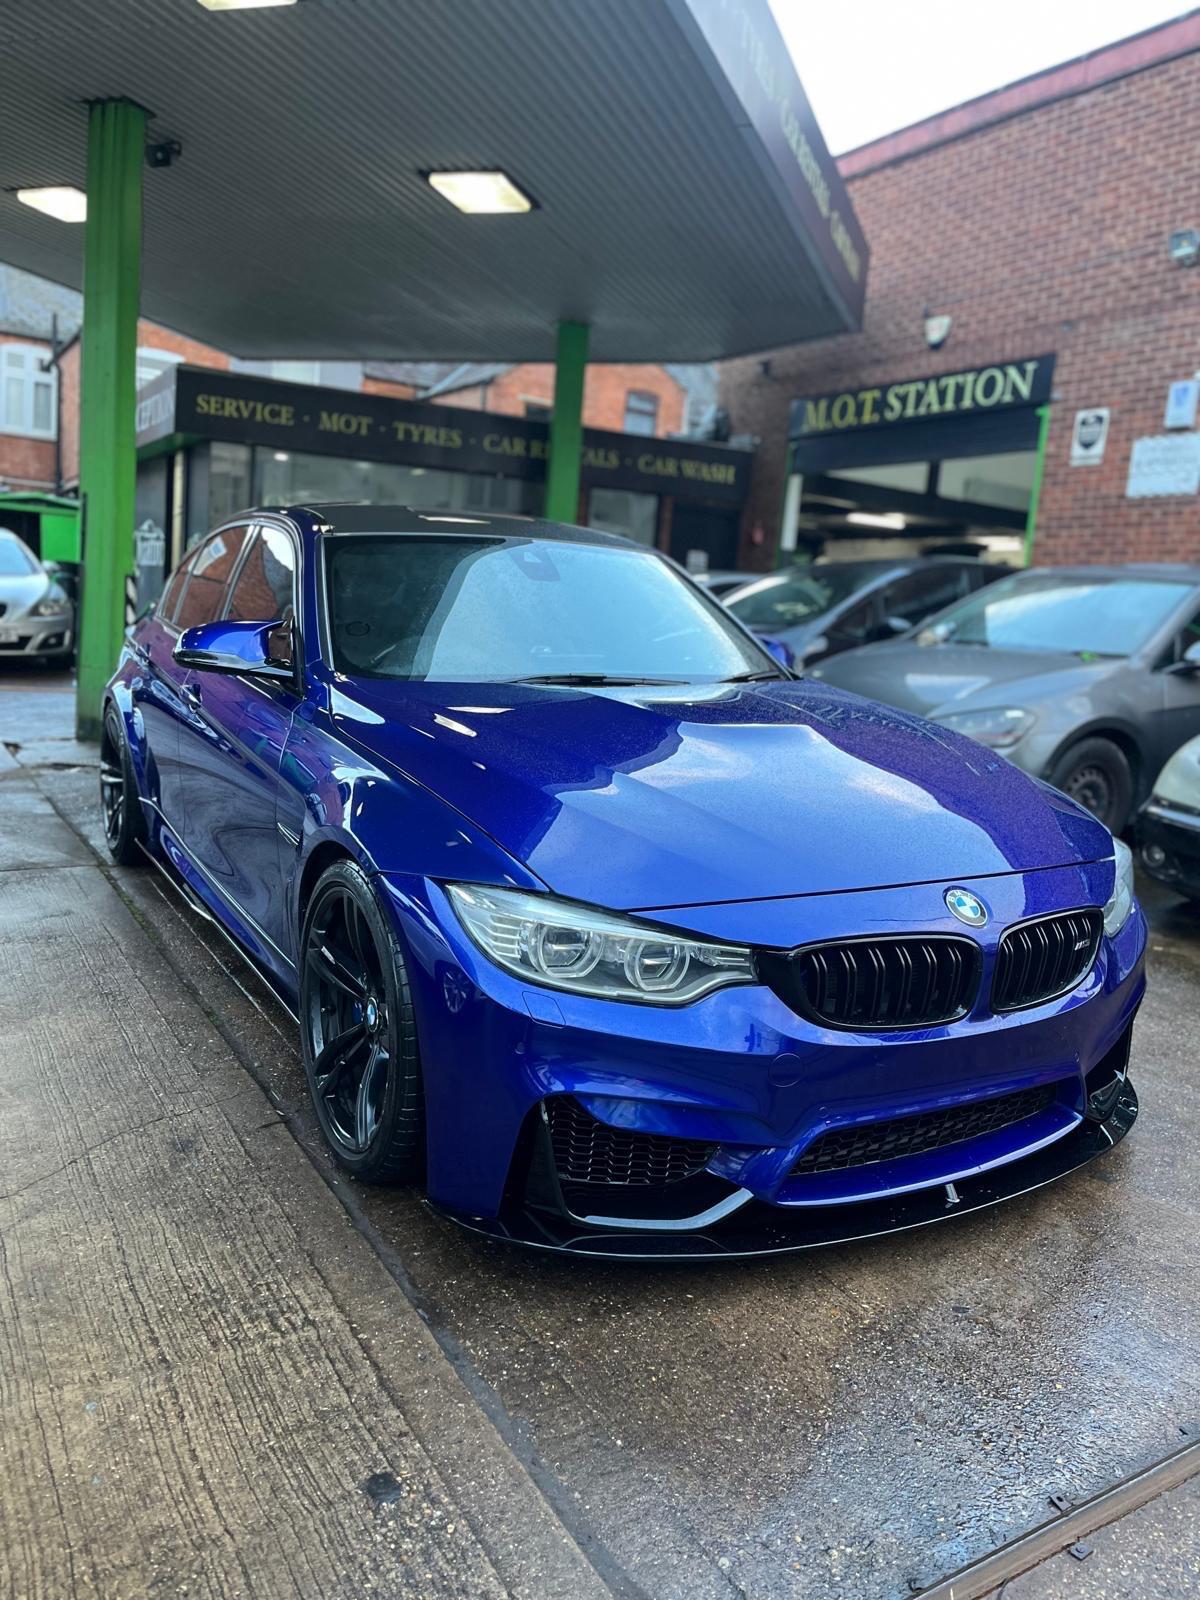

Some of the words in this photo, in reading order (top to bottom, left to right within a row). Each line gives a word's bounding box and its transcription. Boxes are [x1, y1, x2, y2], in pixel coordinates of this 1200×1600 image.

[884, 361, 1039, 421] STATION
[196, 394, 294, 426] SERVICE
[319, 411, 373, 436] MOT
[393, 421, 462, 448] TYRES
[482, 433, 526, 456] CAR
[638, 453, 678, 478] CAR
[681, 459, 736, 485] WASH
